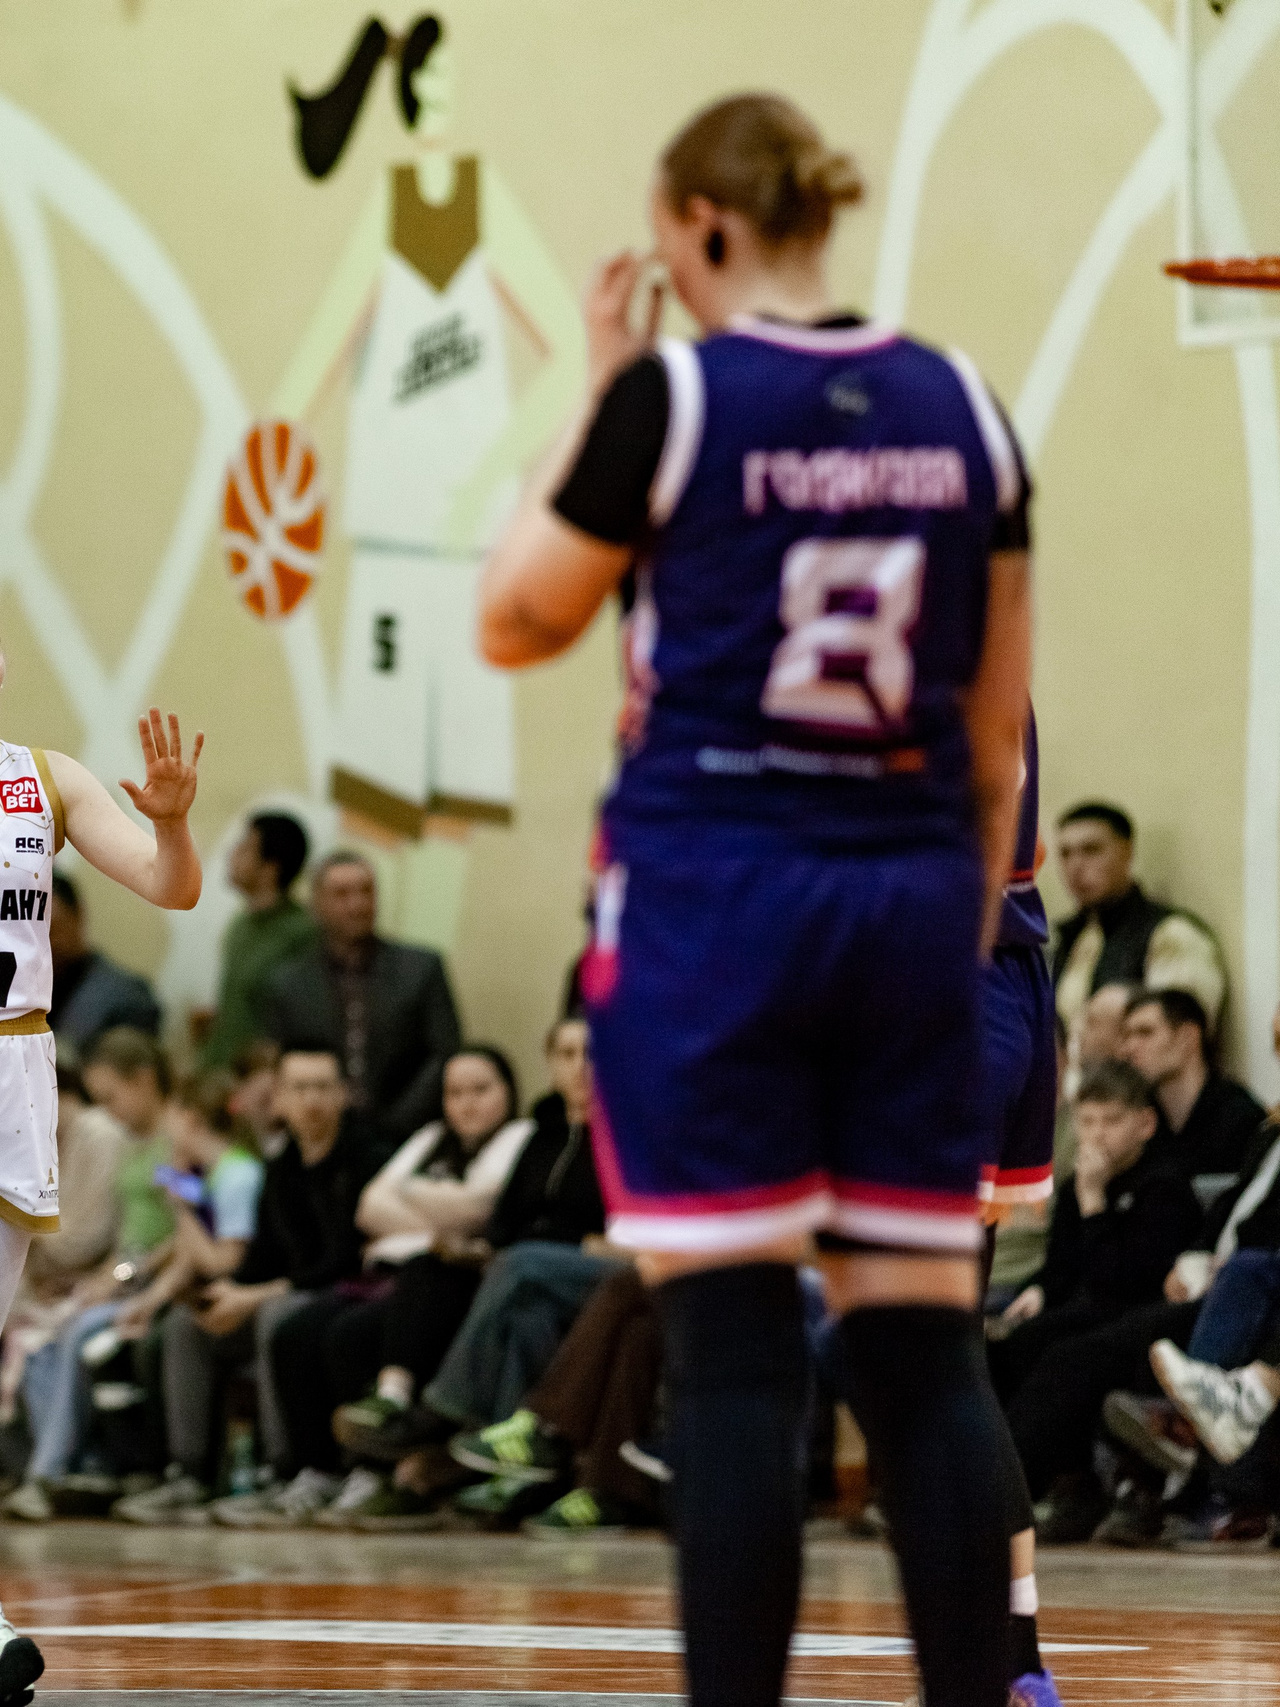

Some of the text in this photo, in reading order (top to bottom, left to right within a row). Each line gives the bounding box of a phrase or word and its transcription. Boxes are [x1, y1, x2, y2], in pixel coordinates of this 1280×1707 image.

[760, 536, 927, 735] 8
[2, 780, 36, 796] FON
[6, 793, 38, 809] BET
